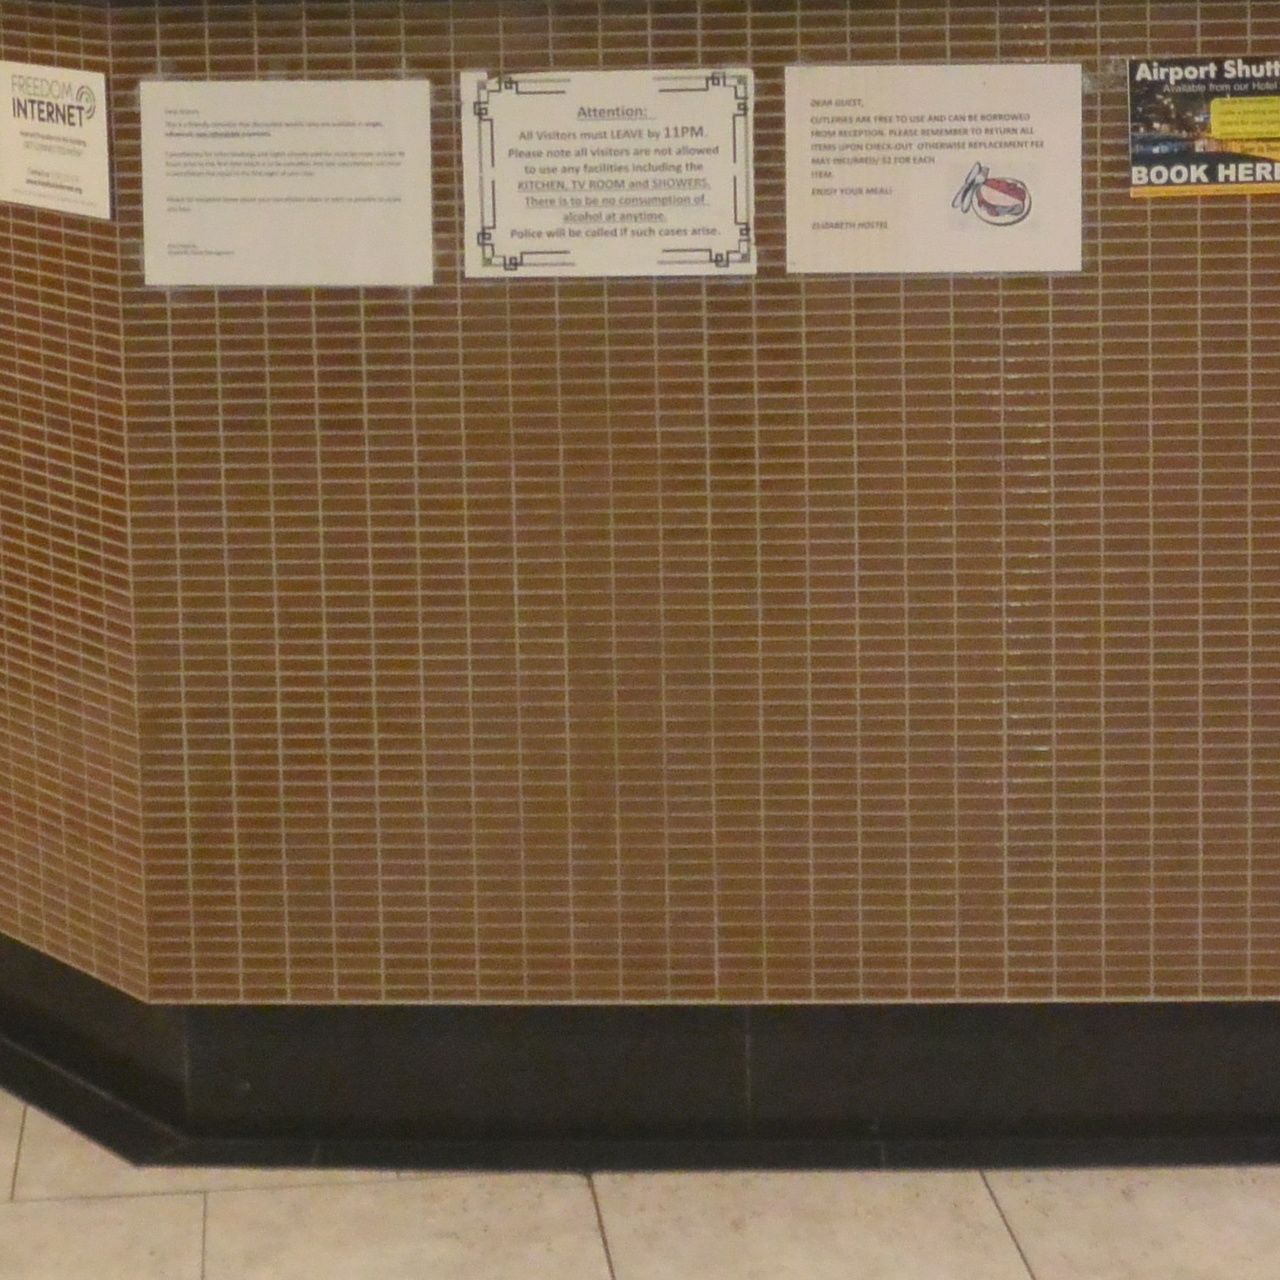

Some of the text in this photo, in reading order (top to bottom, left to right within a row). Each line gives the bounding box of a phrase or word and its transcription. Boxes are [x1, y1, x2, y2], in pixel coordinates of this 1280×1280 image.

[1135, 61, 1218, 85] Airport
[11, 74, 73, 100] FREEDOM
[1163, 82, 1206, 94] Available
[1209, 81, 1231, 92] from
[1234, 83, 1250, 92] our
[1252, 80, 1278, 91] Hotel
[12, 97, 85, 127] INTERNET
[577, 106, 648, 119] Attention:
[895, 115, 908, 123] TO
[928, 114, 946, 122] AND
[948, 114, 966, 122] CAN
[968, 114, 978, 122] BE
[519, 131, 533, 141] All
[536, 130, 576, 141] Visitors
[580, 130, 607, 140] must
[610, 130, 643, 140] LEAVE
[647, 129, 660, 140] by
[888, 128, 918, 137] PLEASE
[921, 127, 968, 136] REMEMBER
[971, 127, 982, 135] TO
[984, 127, 1018, 135] RETURN
[1020, 126, 1034, 134] ALL
[916, 141, 965, 150] OTHERWISE
[968, 140, 1028, 149] REPLACEMENT
[508, 146, 719, 158] Please note all visitors are not allowed
[524, 162, 704, 176] to use any facilities including the
[1131, 164, 1209, 185] BOOK
[571, 180, 586, 190] TV
[589, 179, 625, 190] ROOM
[628, 179, 649, 190] and
[525, 194, 705, 208] There is to be no consumption of
[564, 211, 602, 222] alcohol
[606, 212, 616, 221] at
[510, 228, 543, 239] Police
[546, 228, 566, 238] will
[569, 228, 582, 238] be
[585, 227, 618, 238] called
[620, 227, 628, 237] if
[631, 226, 656, 237] such
[659, 228, 688, 236] cases
